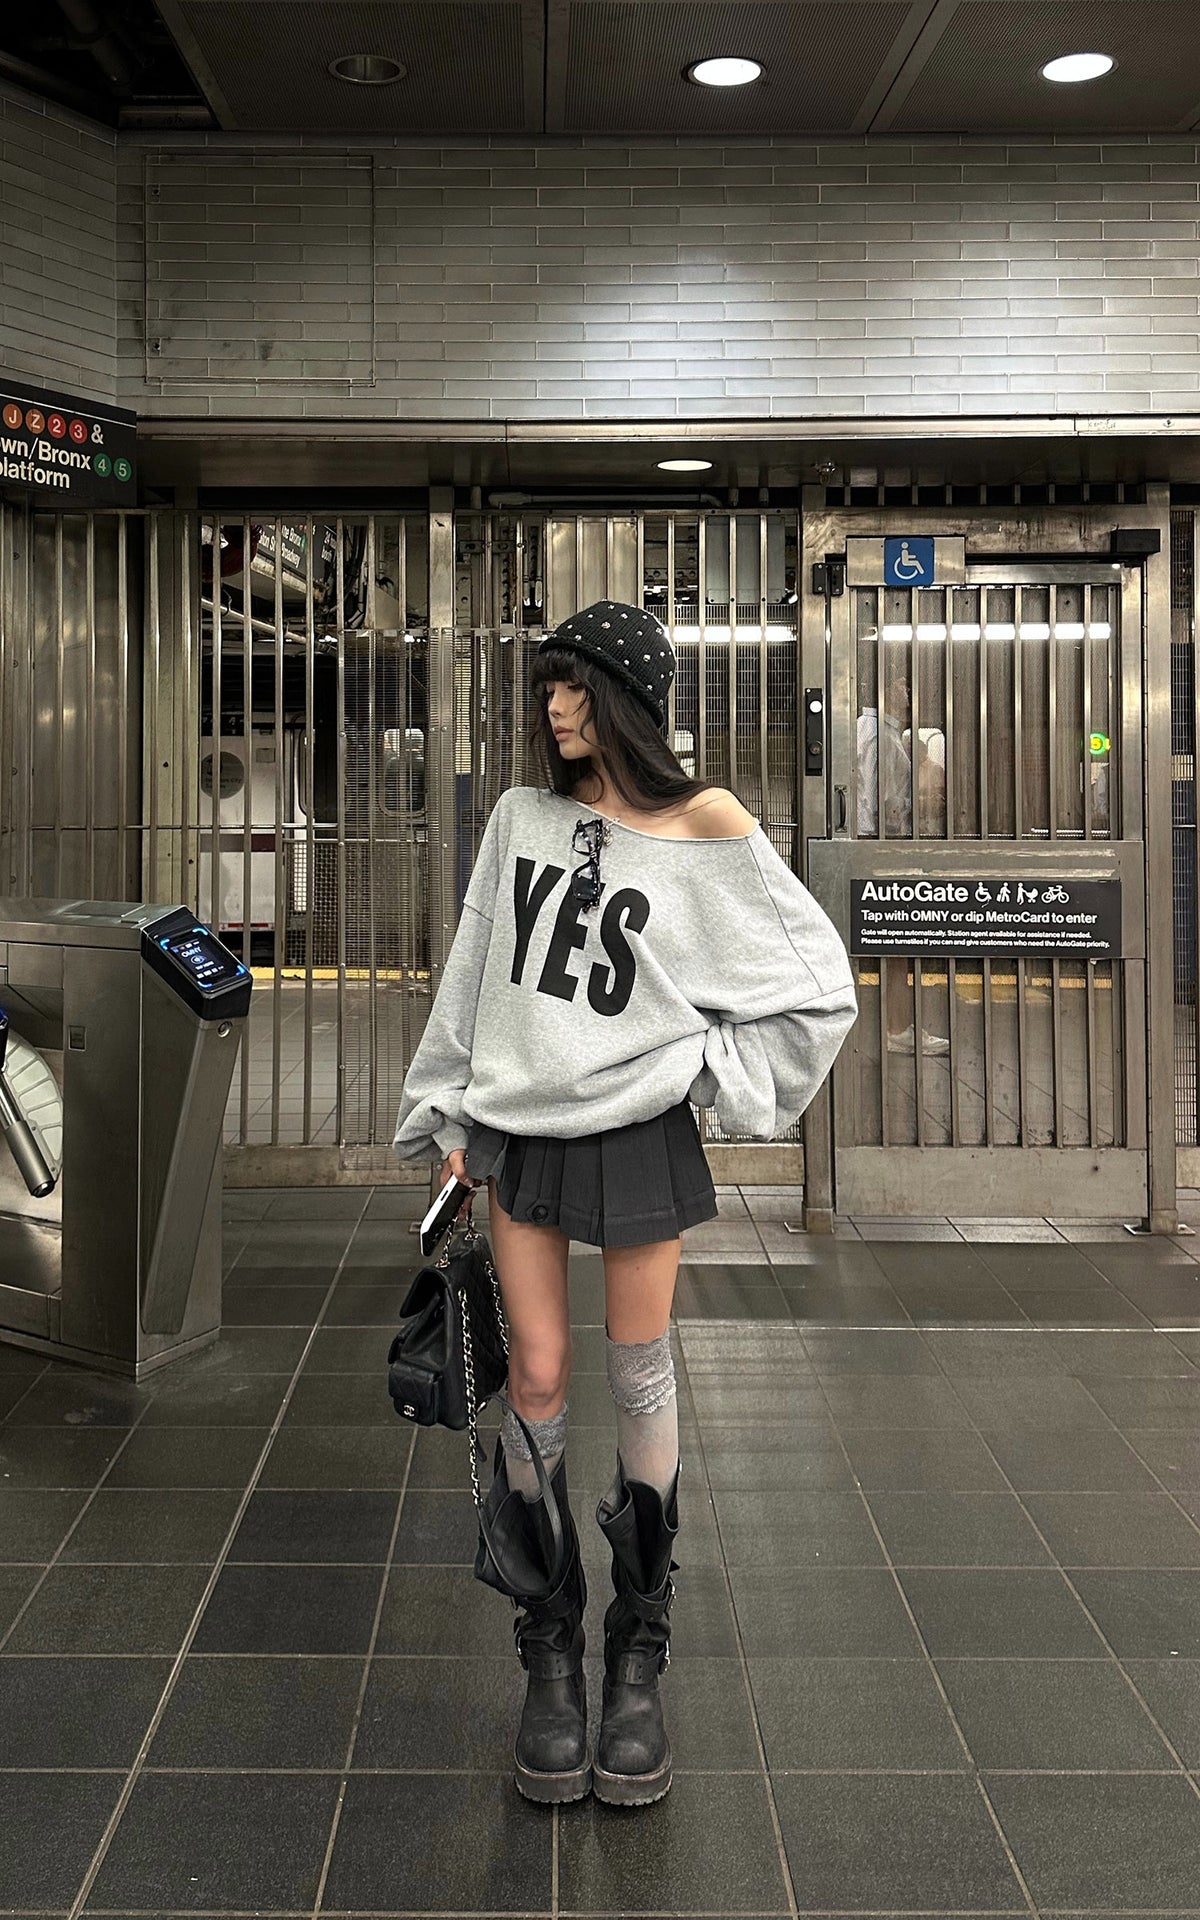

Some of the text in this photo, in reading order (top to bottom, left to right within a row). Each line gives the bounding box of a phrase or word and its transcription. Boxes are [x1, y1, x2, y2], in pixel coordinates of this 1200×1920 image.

[91, 423, 104, 444] &
[0, 456, 70, 489] latform
[861, 881, 968, 902] AutoGate
[861, 909, 1098, 924] Tap with OMNY or dip MetroCard to enter
[510, 856, 650, 1017] YES
[860, 928, 876, 936] Gate
[888, 930, 904, 938] open
[904, 929, 946, 938] automatically.
[947, 929, 970, 937] Station
[988, 930, 1017, 938] available
[860, 937, 882, 945] Please
[894, 937, 924, 945] turnstiles
[965, 938, 980, 947] give
[979, 939, 1013, 947] customers
[1055, 940, 1087, 948] AutoGate
[1086, 940, 1111, 948] priority.
